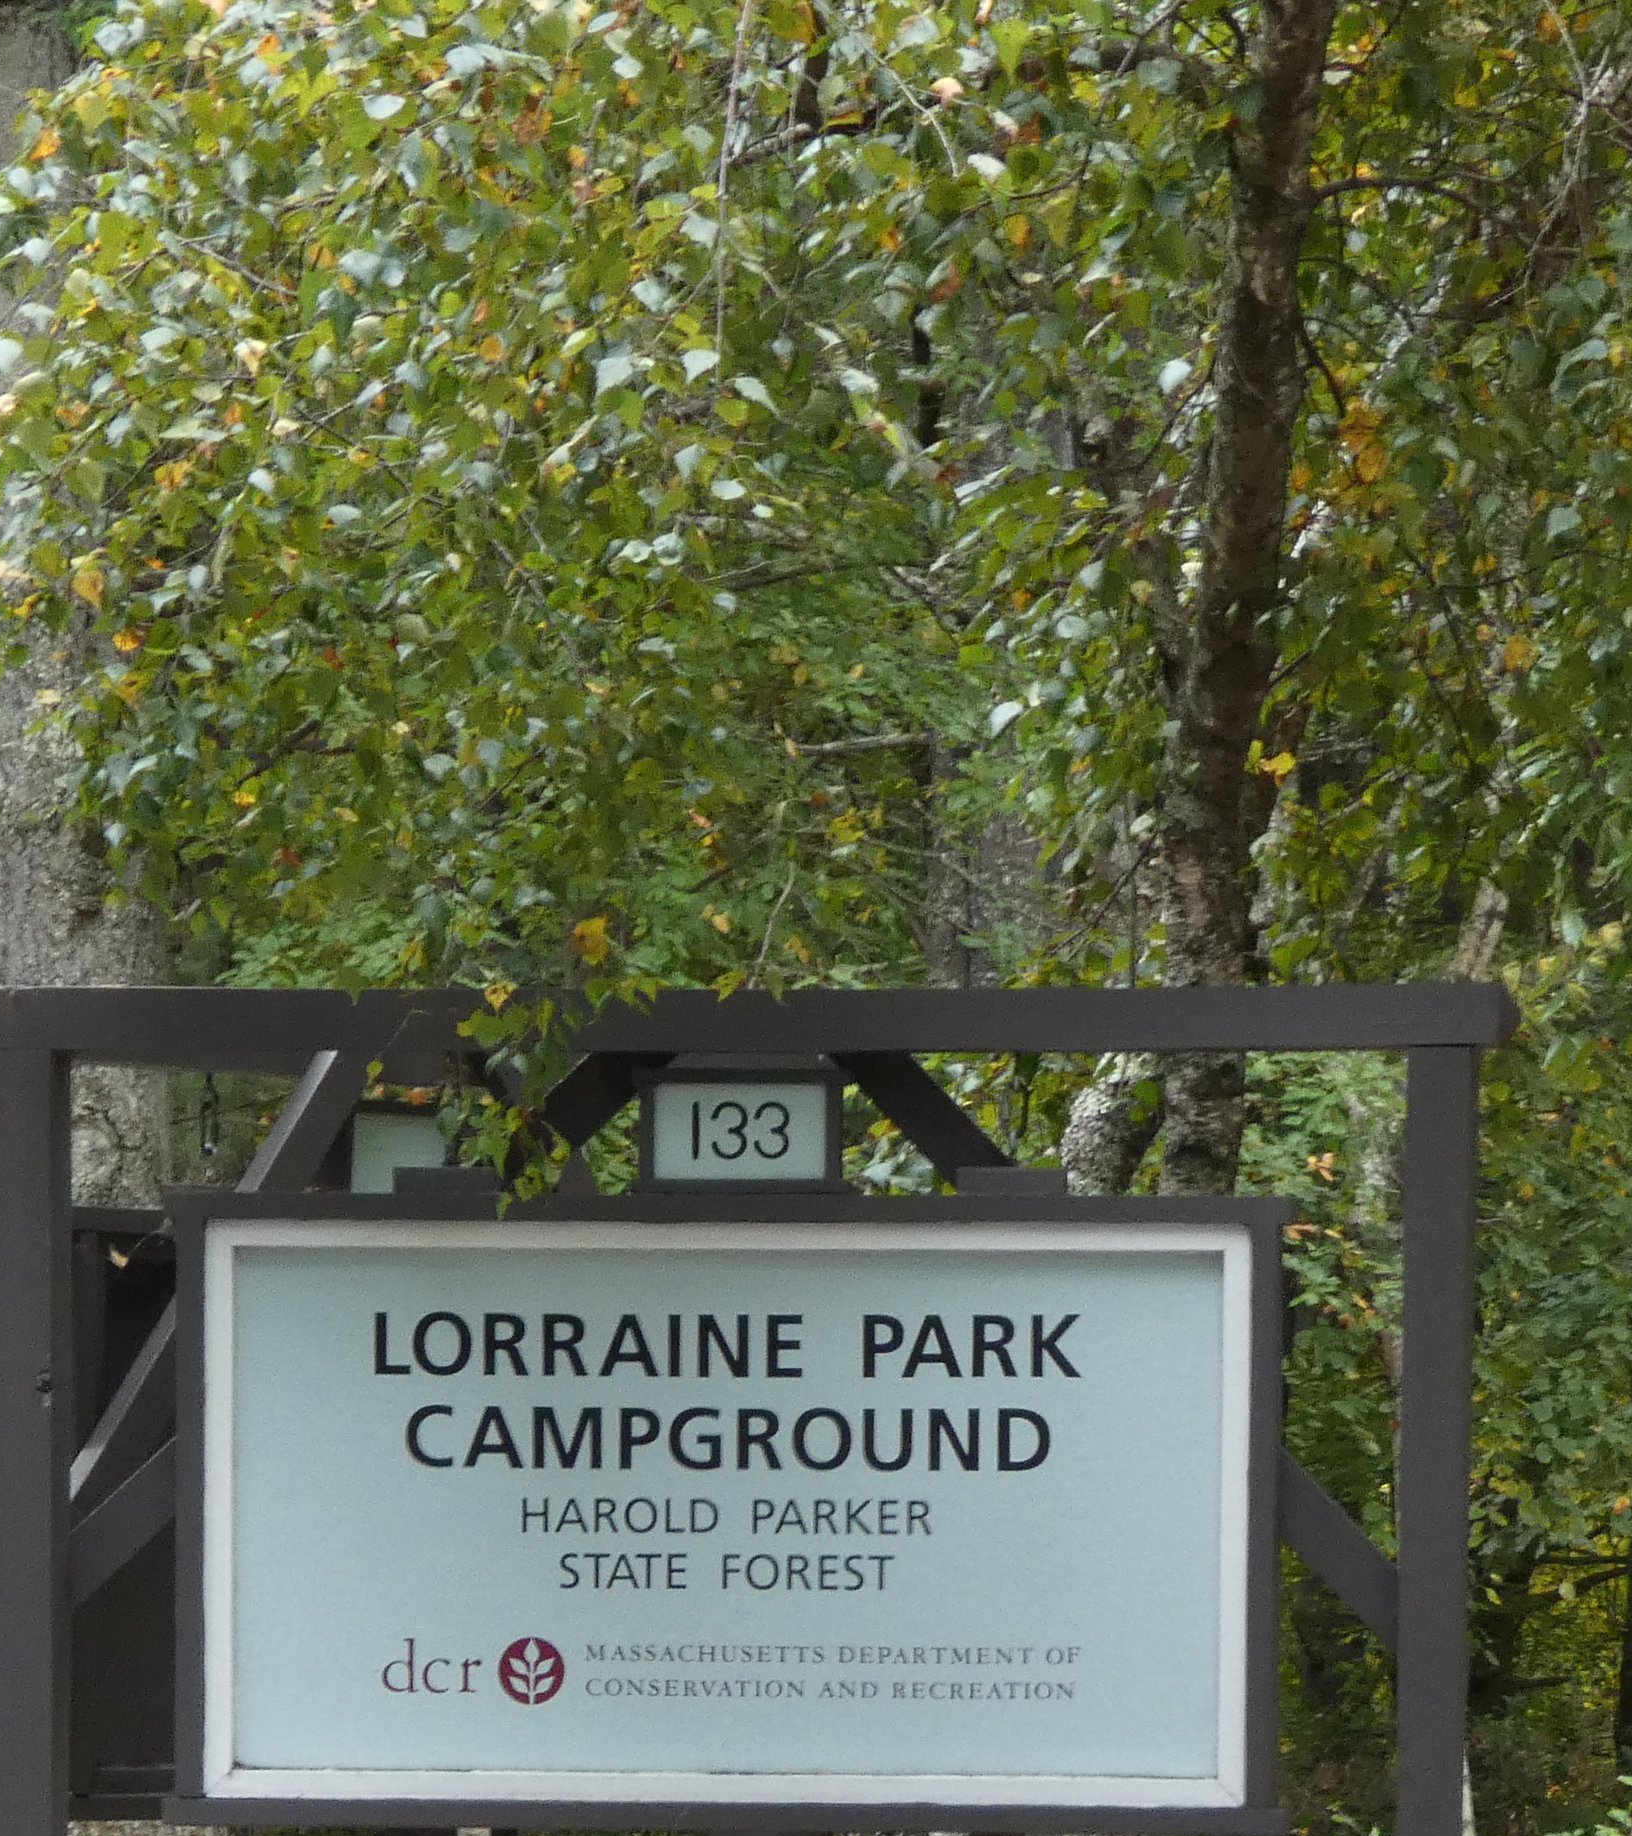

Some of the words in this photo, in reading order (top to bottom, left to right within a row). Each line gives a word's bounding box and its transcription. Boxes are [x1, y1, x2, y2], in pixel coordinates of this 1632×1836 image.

[691, 1100, 791, 1160] 133
[374, 1311, 803, 1378] LORRAINE
[862, 1313, 1081, 1378] PARK
[406, 1404, 1051, 1472] CAMPGROUND
[521, 1497, 719, 1534] HAROLD
[752, 1498, 931, 1535] PARKER
[559, 1552, 688, 1590] STATE
[722, 1553, 895, 1592] FOREST
[382, 1637, 483, 1694] dcr
[585, 1644, 825, 1664] MASSACHUSETTS
[837, 1645, 1035, 1665] DEPARTMENT
[1045, 1646, 1081, 1665] OF
[584, 1678, 804, 1698] CONSERVATION
[818, 1681, 879, 1699] AND
[892, 1681, 1073, 1700] RECREATION
